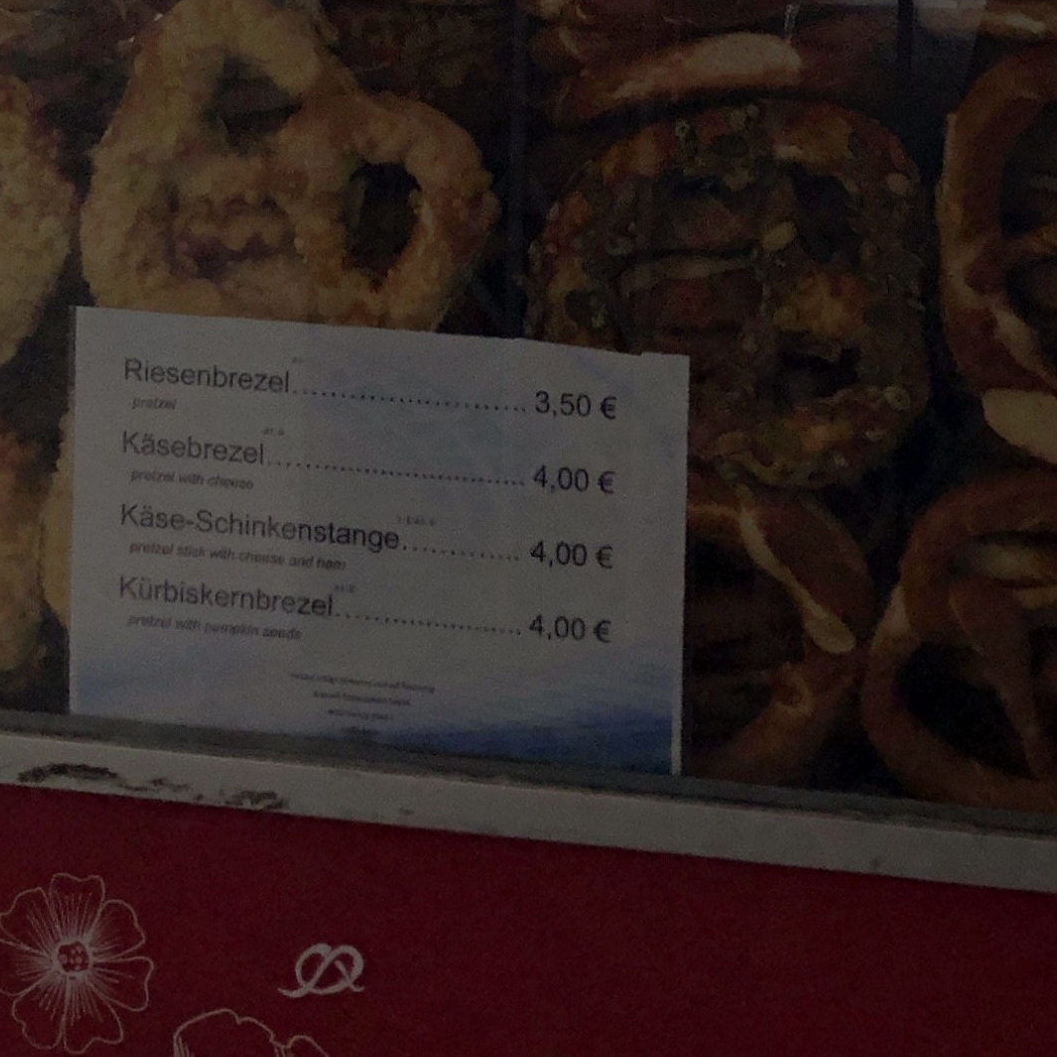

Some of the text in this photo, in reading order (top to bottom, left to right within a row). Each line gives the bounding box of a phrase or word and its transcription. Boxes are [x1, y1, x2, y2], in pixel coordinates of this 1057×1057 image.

[124, 357, 618, 420] Riesenbrezel 3,50 €
[122, 430, 615, 495] Käsebrezel 4,00 €
[179, 474, 204, 486] with
[120, 502, 400, 553] Käse-Schinkenstange
[530, 539, 588, 568] 4,00
[595, 545, 614, 570] €
[129, 541, 174, 556] pretzel
[209, 547, 235, 561] with
[238, 549, 285, 566] cheese
[290, 554, 313, 568] and
[119, 575, 612, 644] Kürbiskernbrezel 4,00 €
